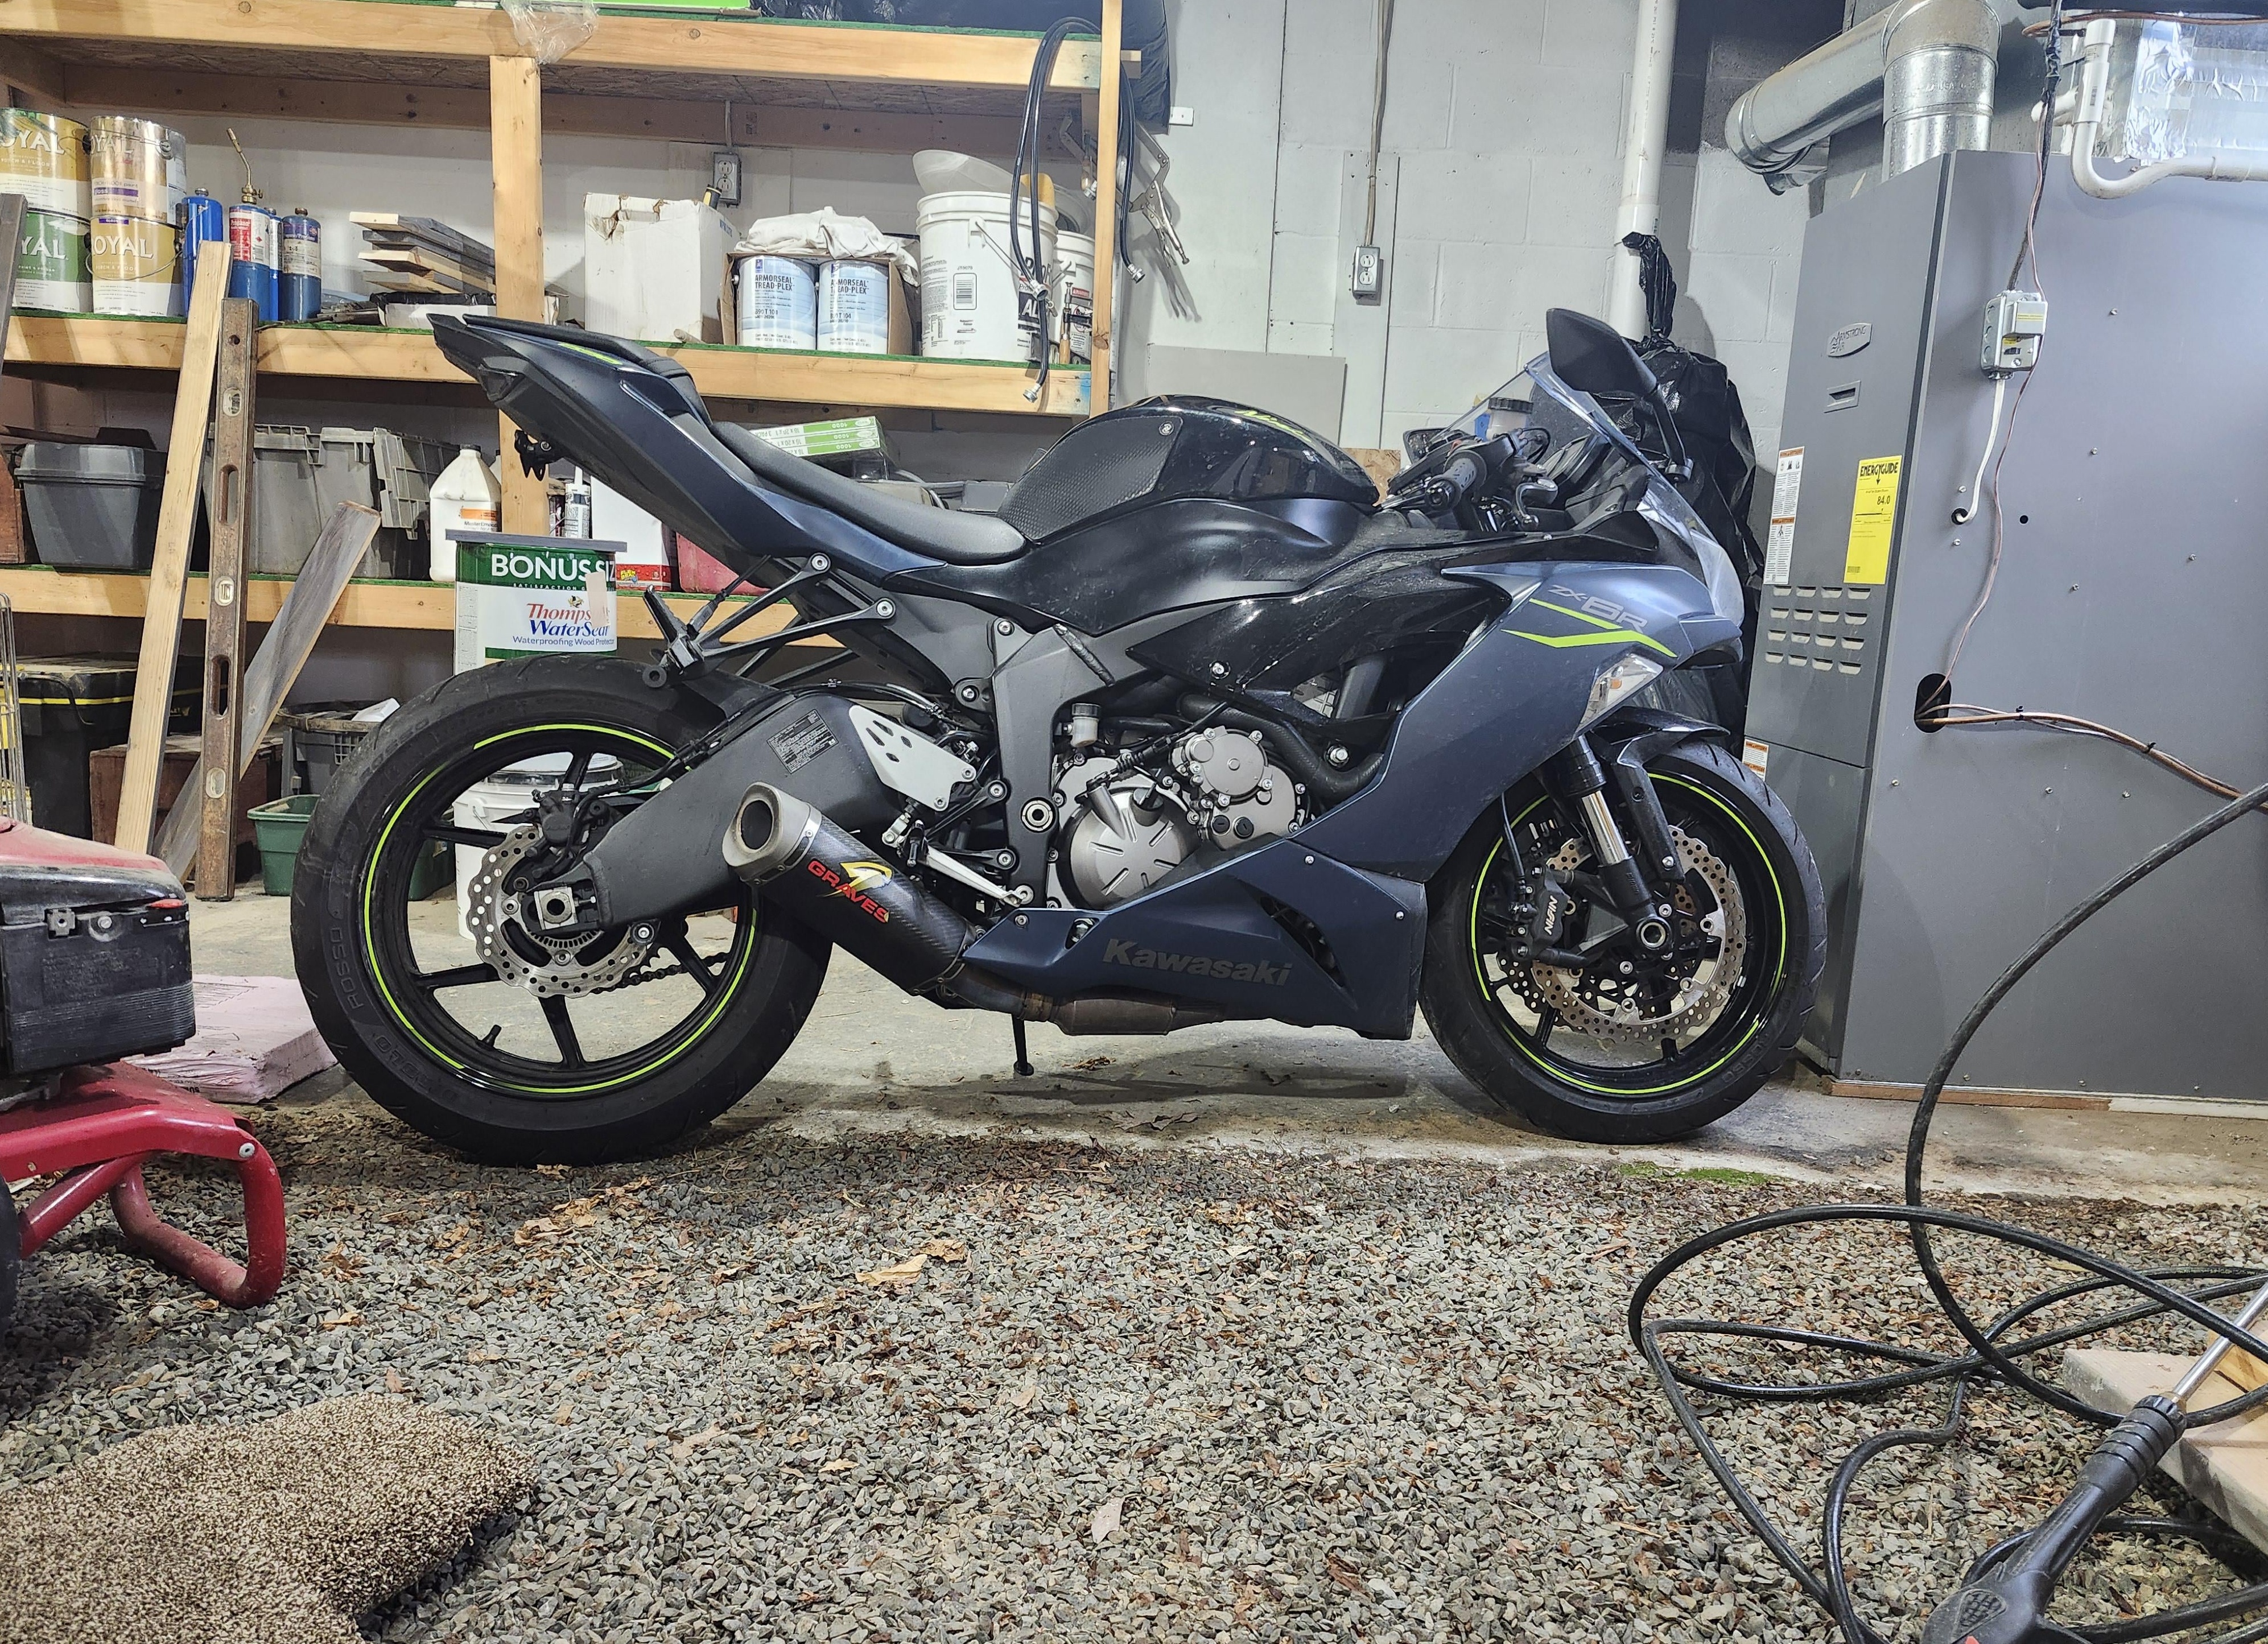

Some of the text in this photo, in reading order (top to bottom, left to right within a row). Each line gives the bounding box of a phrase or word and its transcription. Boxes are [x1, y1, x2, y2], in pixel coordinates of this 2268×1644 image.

[21, 236, 67, 260] YAL
[754, 275, 793, 284] ARMORSEAL
[754, 282, 793, 291] TREAD-PLEX
[830, 279, 868, 287] AMORSEAL
[1860, 462, 1899, 478] ENERGYGUIDE
[1877, 495, 1891, 505] 84.0
[491, 552, 592, 582] BONUS
[513, 583, 578, 591] SATISFACTION
[527, 603, 592, 625] Thomps
[512, 635, 574, 647] Waterproofing
[595, 638, 615, 646] Protector
[807, 858, 890, 923] GRAVES
[1544, 895, 1558, 935] NISSIN
[329, 926, 365, 1010] ROSSO
[1102, 938, 1292, 987] Kawasaki
